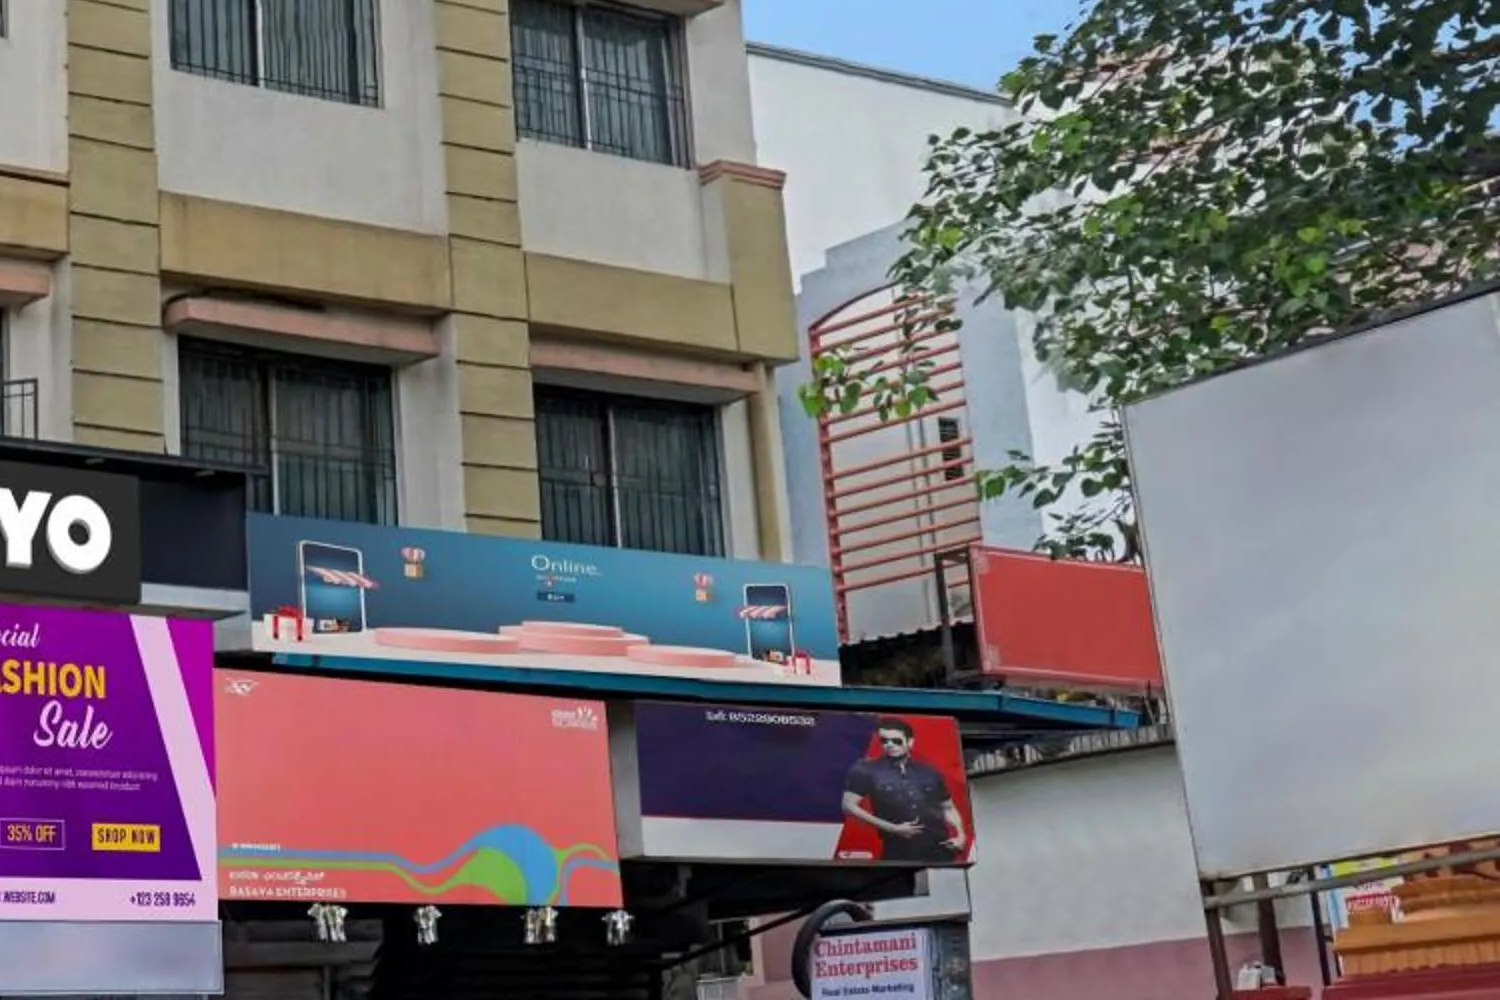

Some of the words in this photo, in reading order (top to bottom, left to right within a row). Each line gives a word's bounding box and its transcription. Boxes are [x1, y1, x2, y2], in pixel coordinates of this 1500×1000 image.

[33, 700, 113, 749] Sale
[7, 824, 32, 842] 35%
[35, 825, 56, 843] OFF
[97, 827, 127, 843] SHOP
[131, 829, 155, 844] NOW
[814, 932, 917, 957] Chintamani
[815, 956, 918, 979] Enterprises
[821, 987, 841, 997] Real
[871, 983, 915, 994] Marketing
